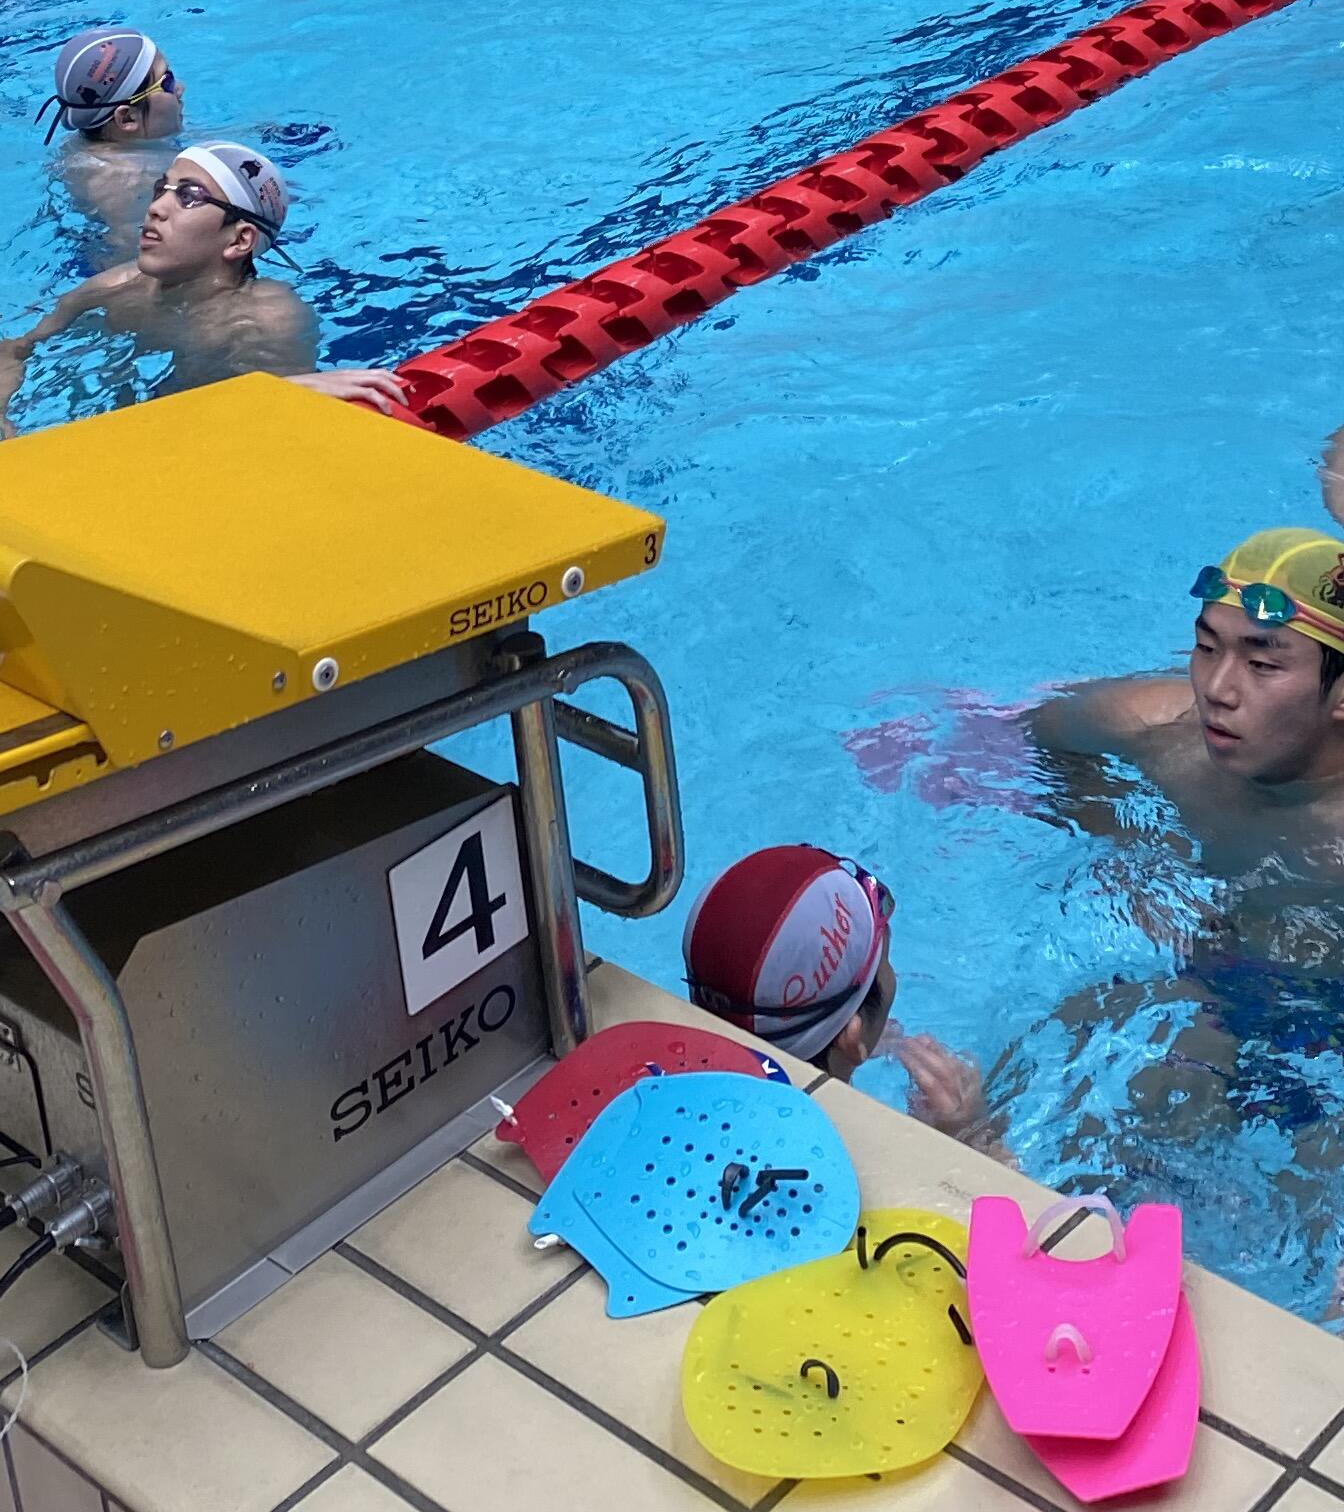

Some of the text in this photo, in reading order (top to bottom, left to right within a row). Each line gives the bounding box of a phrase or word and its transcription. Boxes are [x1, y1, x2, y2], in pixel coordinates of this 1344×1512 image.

[449, 581, 549, 637] SEIKO
[644, 533, 657, 565] 3
[422, 830, 507, 961] 4
[781, 892, 855, 1022] Luther
[330, 984, 516, 1143] SEIKO
